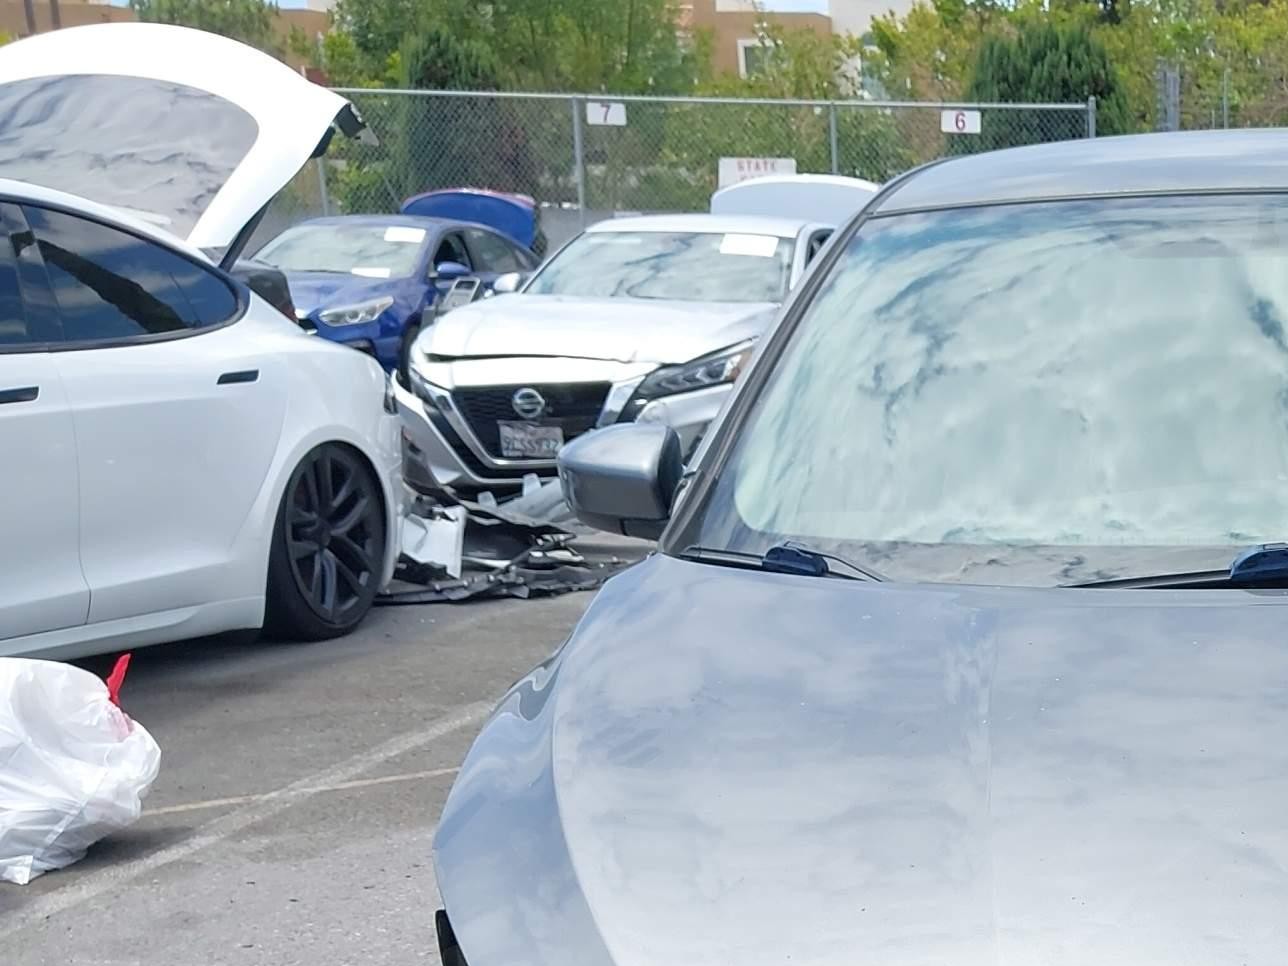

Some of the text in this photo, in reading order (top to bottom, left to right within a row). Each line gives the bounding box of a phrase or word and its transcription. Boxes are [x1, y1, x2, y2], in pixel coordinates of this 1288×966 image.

[599, 104, 610, 123] 7
[954, 111, 966, 131] 6
[737, 159, 776, 172] STATE
